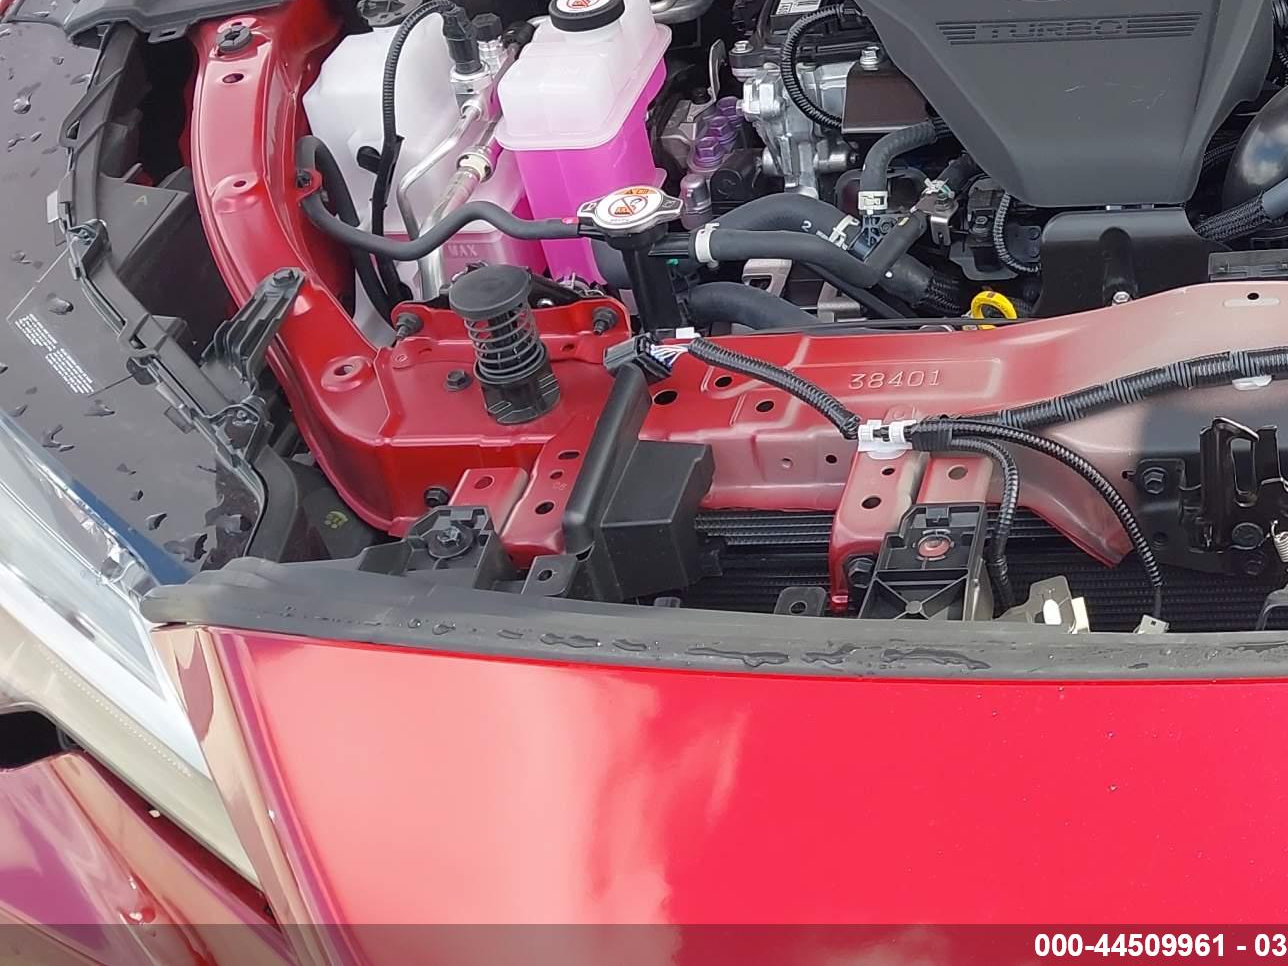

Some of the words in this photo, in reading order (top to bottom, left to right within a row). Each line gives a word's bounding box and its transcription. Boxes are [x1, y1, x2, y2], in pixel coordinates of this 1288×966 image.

[981, 19, 1123, 38] TURBO
[446, 244, 478, 257] MAX
[848, 369, 941, 390] 38401
